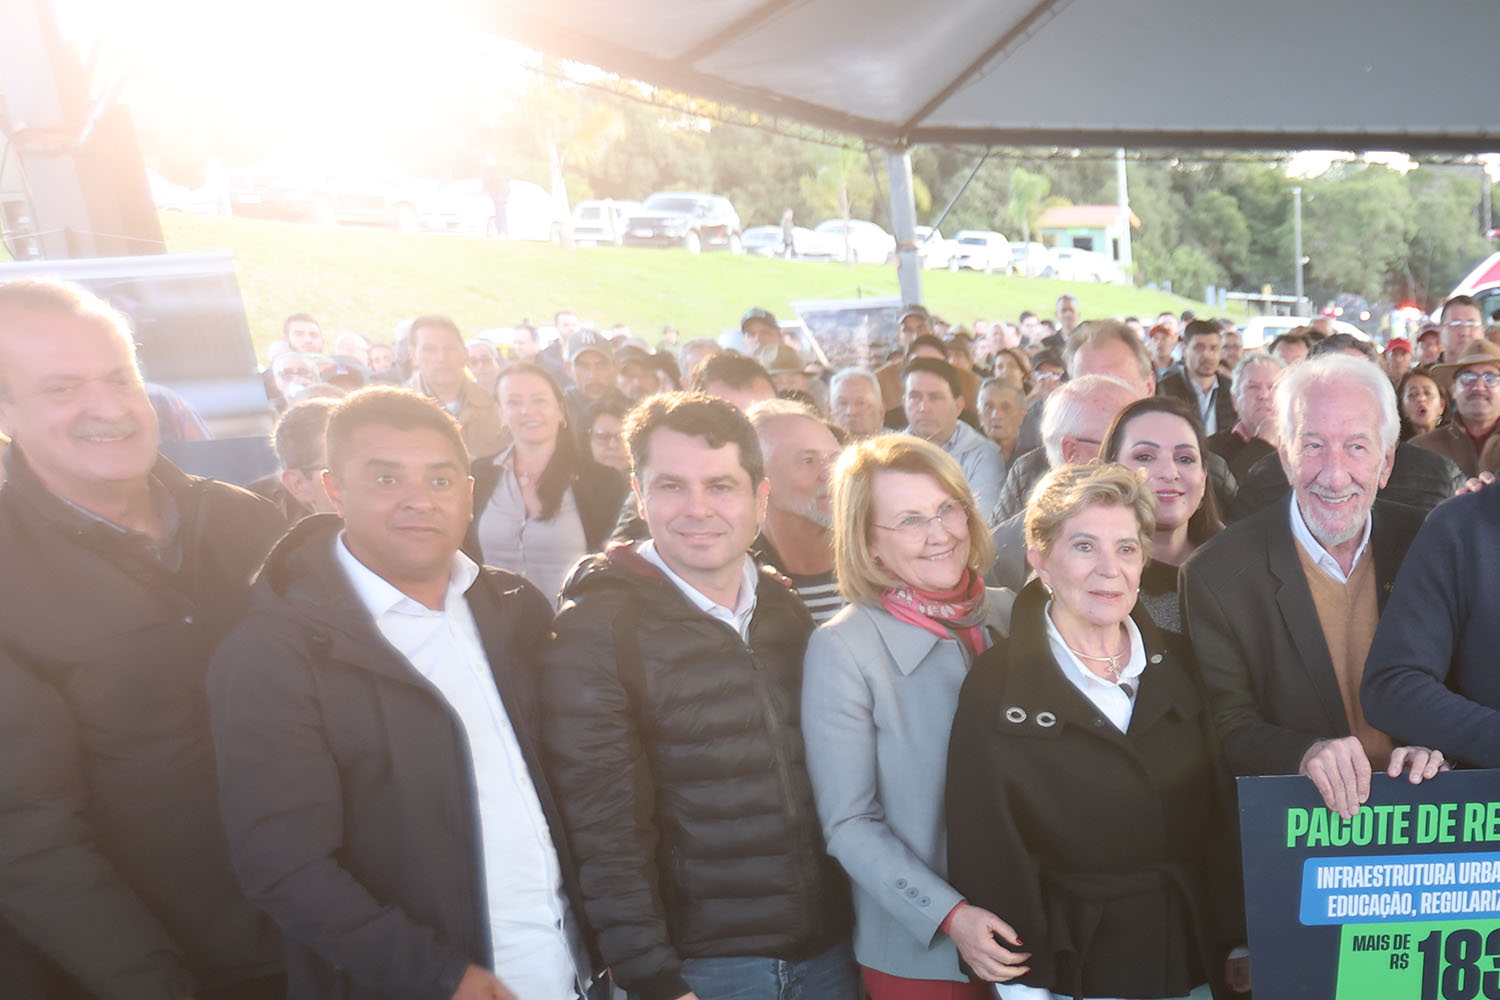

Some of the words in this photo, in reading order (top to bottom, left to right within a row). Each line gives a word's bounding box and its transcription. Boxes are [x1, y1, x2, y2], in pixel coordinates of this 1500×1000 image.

[1287, 804, 1411, 848] PACOTE
[1417, 803, 1457, 844] DE
[1317, 862, 1455, 888] INFRAESTRUTURA
[1327, 891, 1417, 919] EDUCAÇÃO,
[1353, 935, 1389, 952] MAIS
[1393, 934, 1411, 951] DE
[1389, 952, 1410, 970] R$
